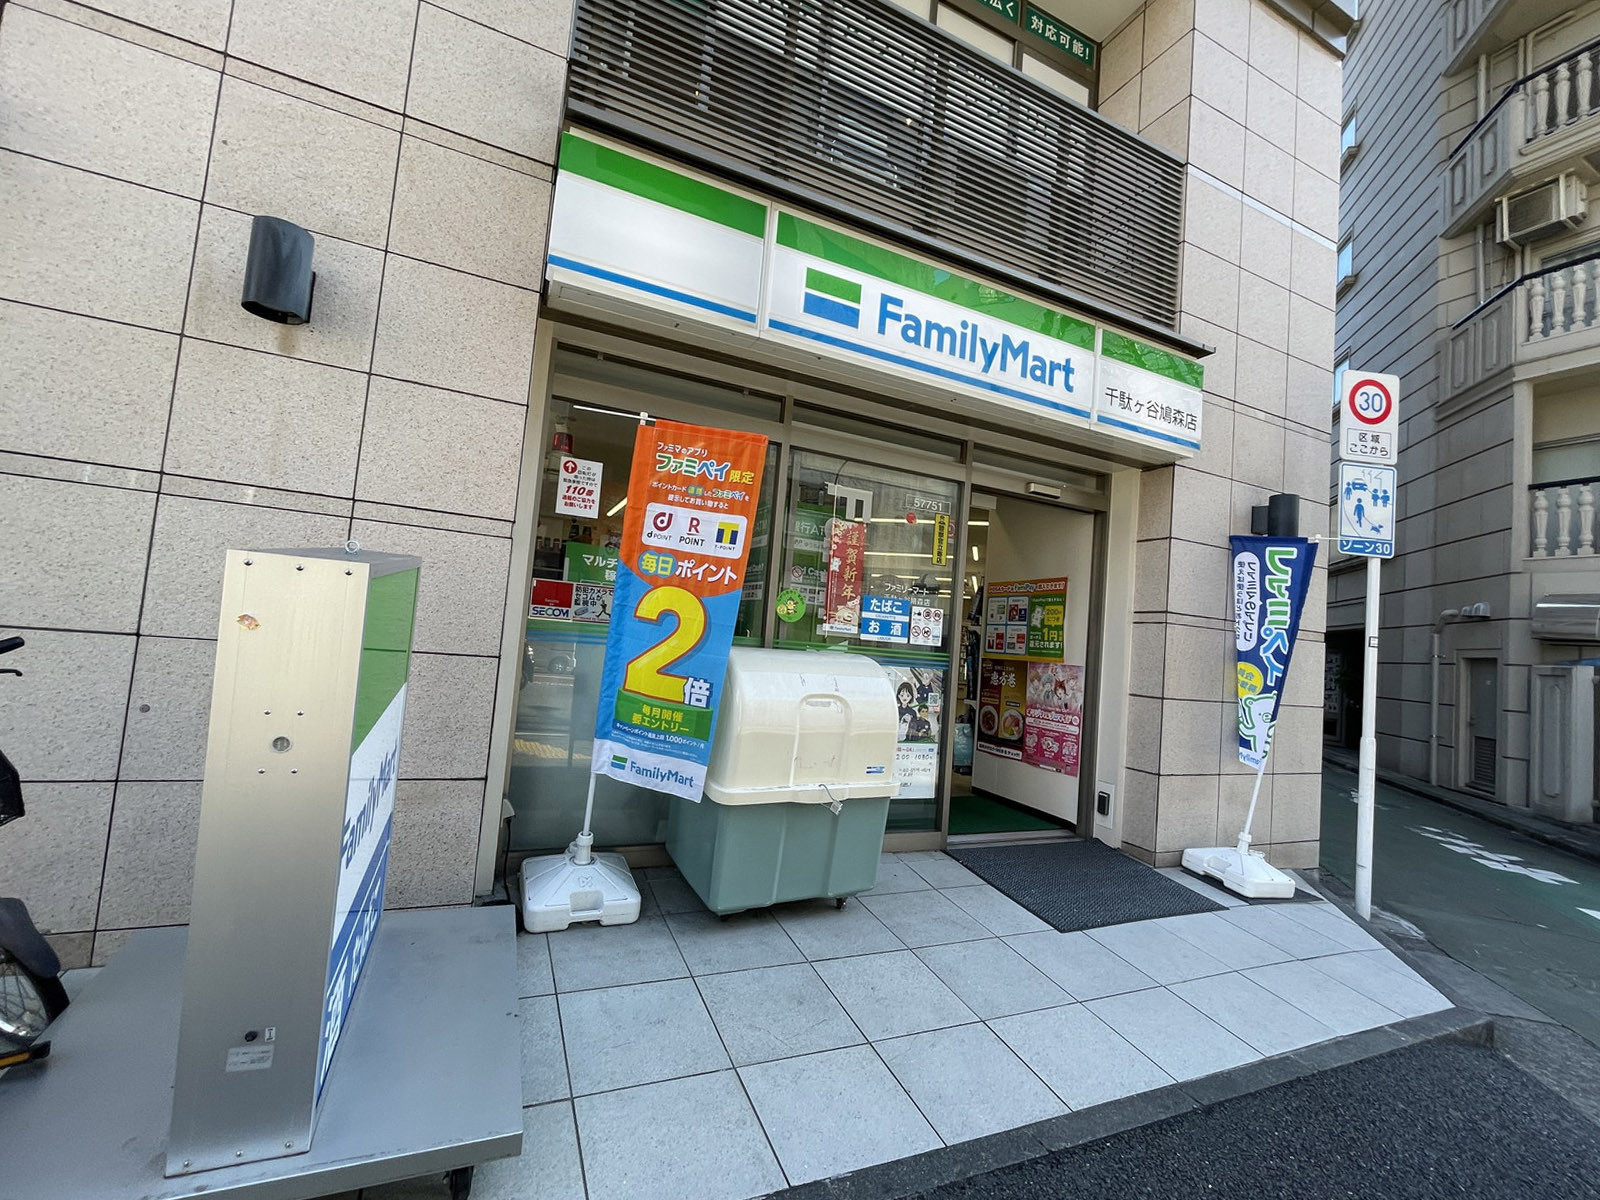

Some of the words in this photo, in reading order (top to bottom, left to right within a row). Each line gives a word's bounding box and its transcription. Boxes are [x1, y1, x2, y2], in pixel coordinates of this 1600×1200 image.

[1030, 15, 1089, 60] 対応可能!
[877, 293, 1075, 393] FamilyMart
[1105, 387, 1197, 431] 千駄ヶ谷鳩森店
[1358, 391, 1384, 413] 30
[1358, 432, 1381, 445] 区域
[657, 441, 708, 457] ファミマのアプリ
[1349, 442, 1389, 457] ここから
[655, 452, 731, 482] ファミペイ
[729, 469, 755, 485] 限定
[913, 497, 942, 512] 57751
[678, 535, 706, 547] POINT
[841, 530, 860, 600] 謹賀新年
[884, 582, 930, 596] ファミリーマート
[531, 606, 570, 618] SECOM
[869, 598, 903, 614] たばこ
[989, 671, 1016, 688] 恵方巻
[631, 713, 690, 732] 要エントリー
[642, 704, 684, 723] 毎月開催
[629, 761, 695, 788] FamilyMart
[340, 746, 397, 869] FamilyMart
